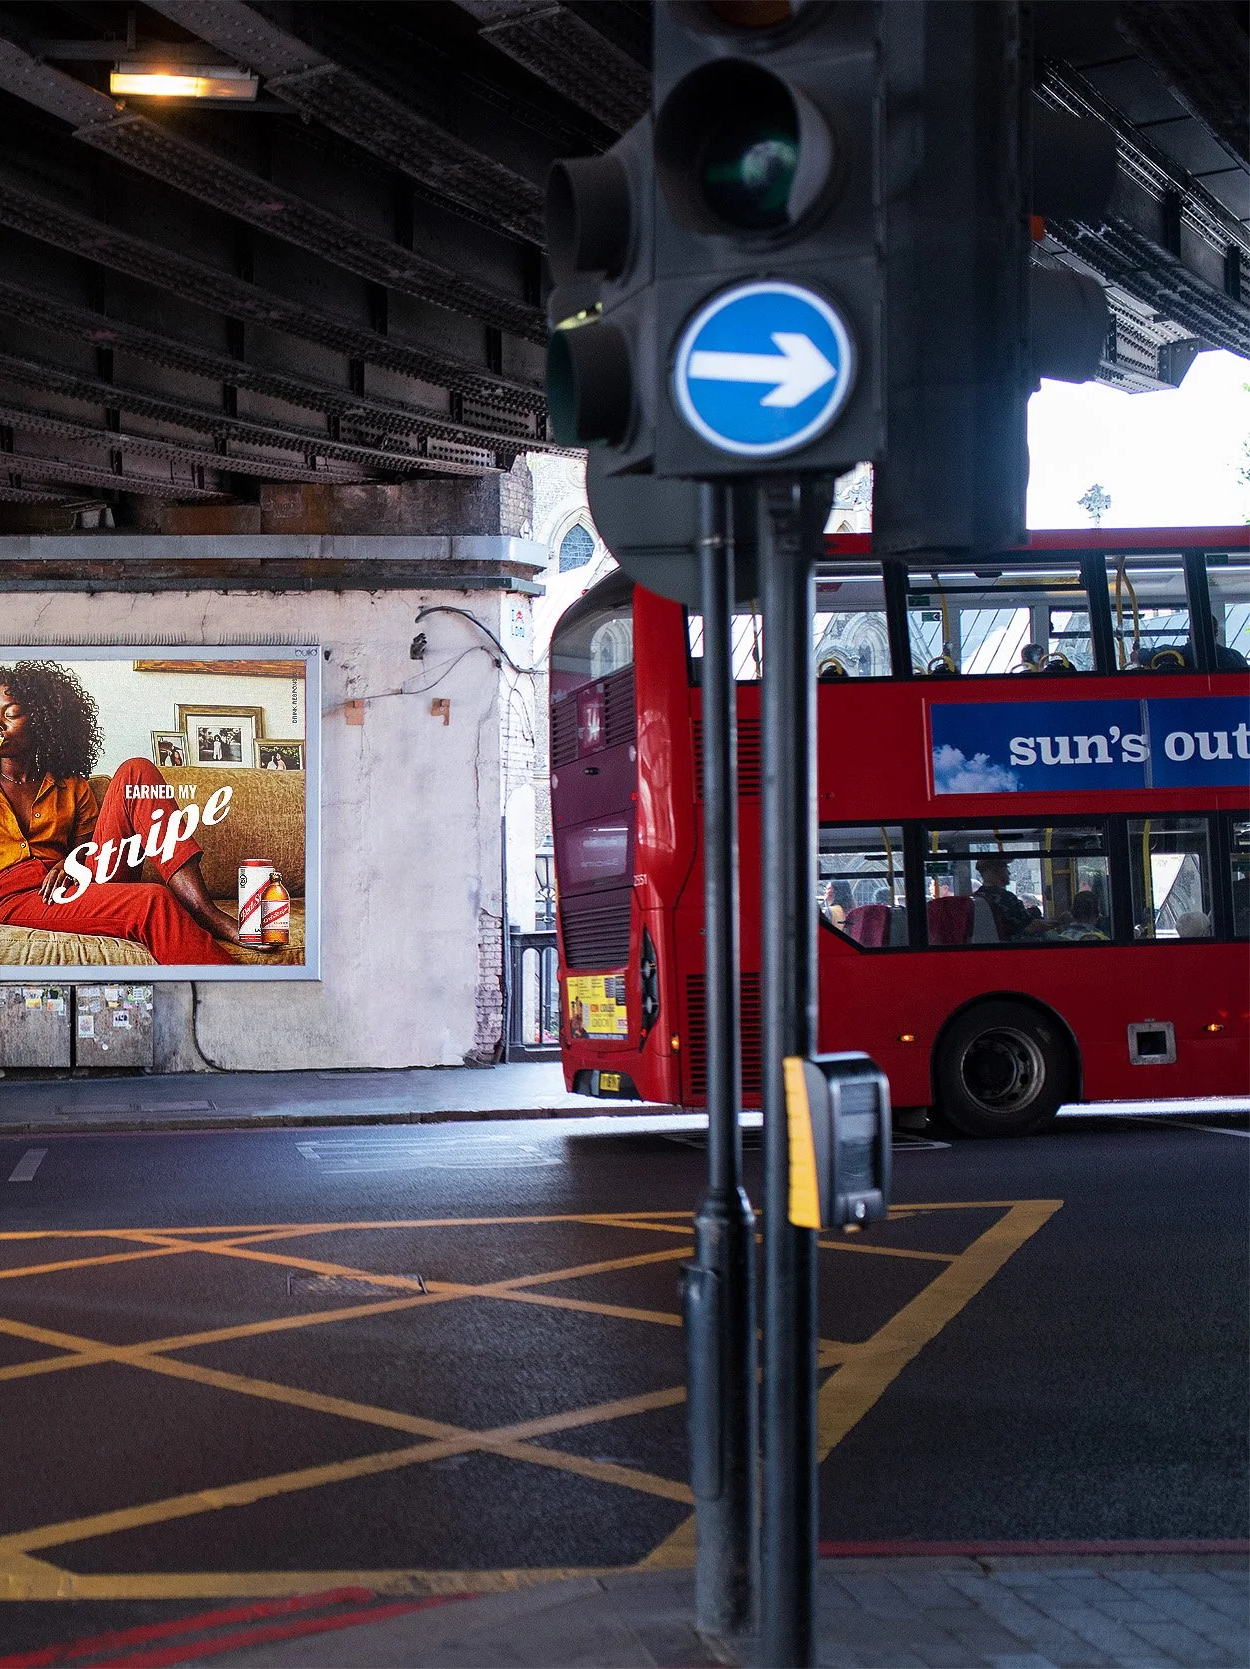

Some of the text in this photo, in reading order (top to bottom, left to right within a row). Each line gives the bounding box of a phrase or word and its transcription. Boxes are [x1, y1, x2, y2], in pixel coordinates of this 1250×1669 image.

[1008, 722, 1250, 766] sun's out
[125, 784, 198, 800] EARNED MY
[52, 785, 234, 905] Stripe
